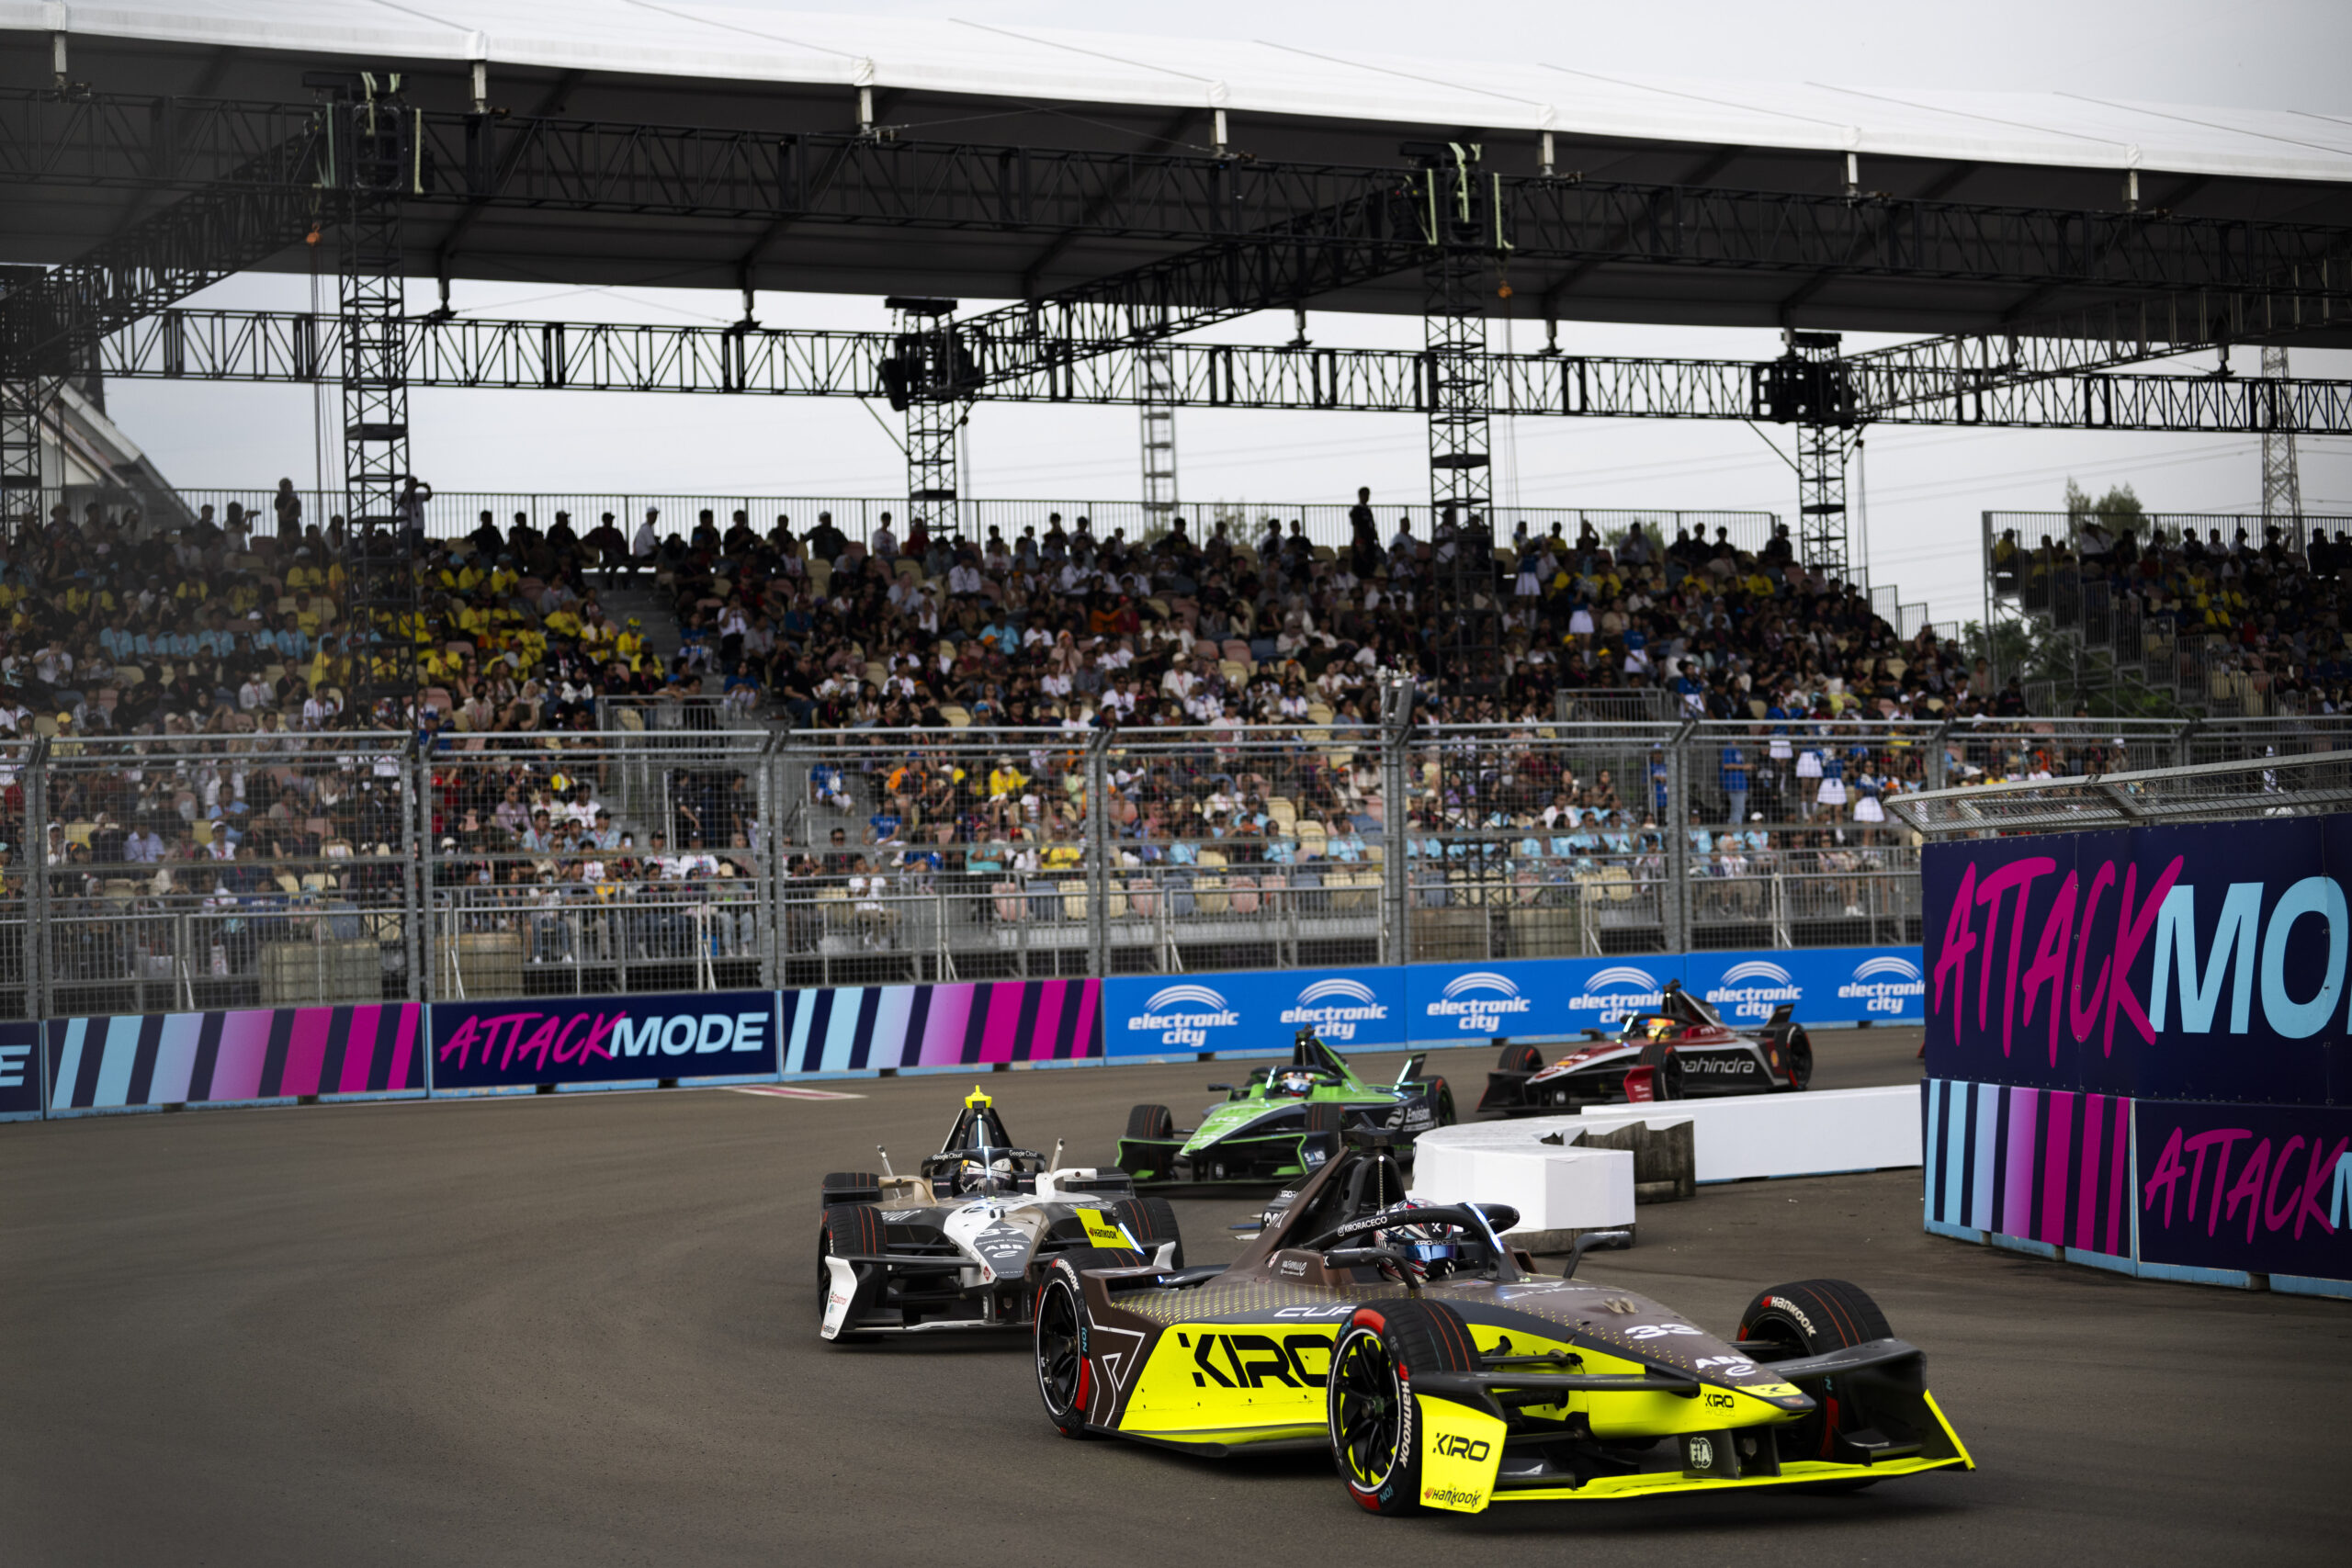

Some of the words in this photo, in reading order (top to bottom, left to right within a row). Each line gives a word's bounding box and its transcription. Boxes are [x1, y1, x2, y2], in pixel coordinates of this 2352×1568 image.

[1706, 987, 1803, 1004] electronic
[1836, 983, 1924, 998] electroni
[1427, 997, 1531, 1015] electronic
[1569, 991, 1664, 1010] electroni
[1867, 995, 1904, 1013] city
[1281, 1004, 1387, 1023] electronic
[1736, 1001, 1773, 1020] city
[1128, 1010, 1239, 1031] electronic
[1459, 1013, 1501, 1032] city
[1161, 1027, 1207, 1047] city
[1314, 1021, 1355, 1040] city
[1177, 1332, 1334, 1388] KIRO
[1704, 1393, 1734, 1408] KIRO
[1432, 1432, 1490, 1462] KIRO
[1690, 1443, 1710, 1461] FIA
